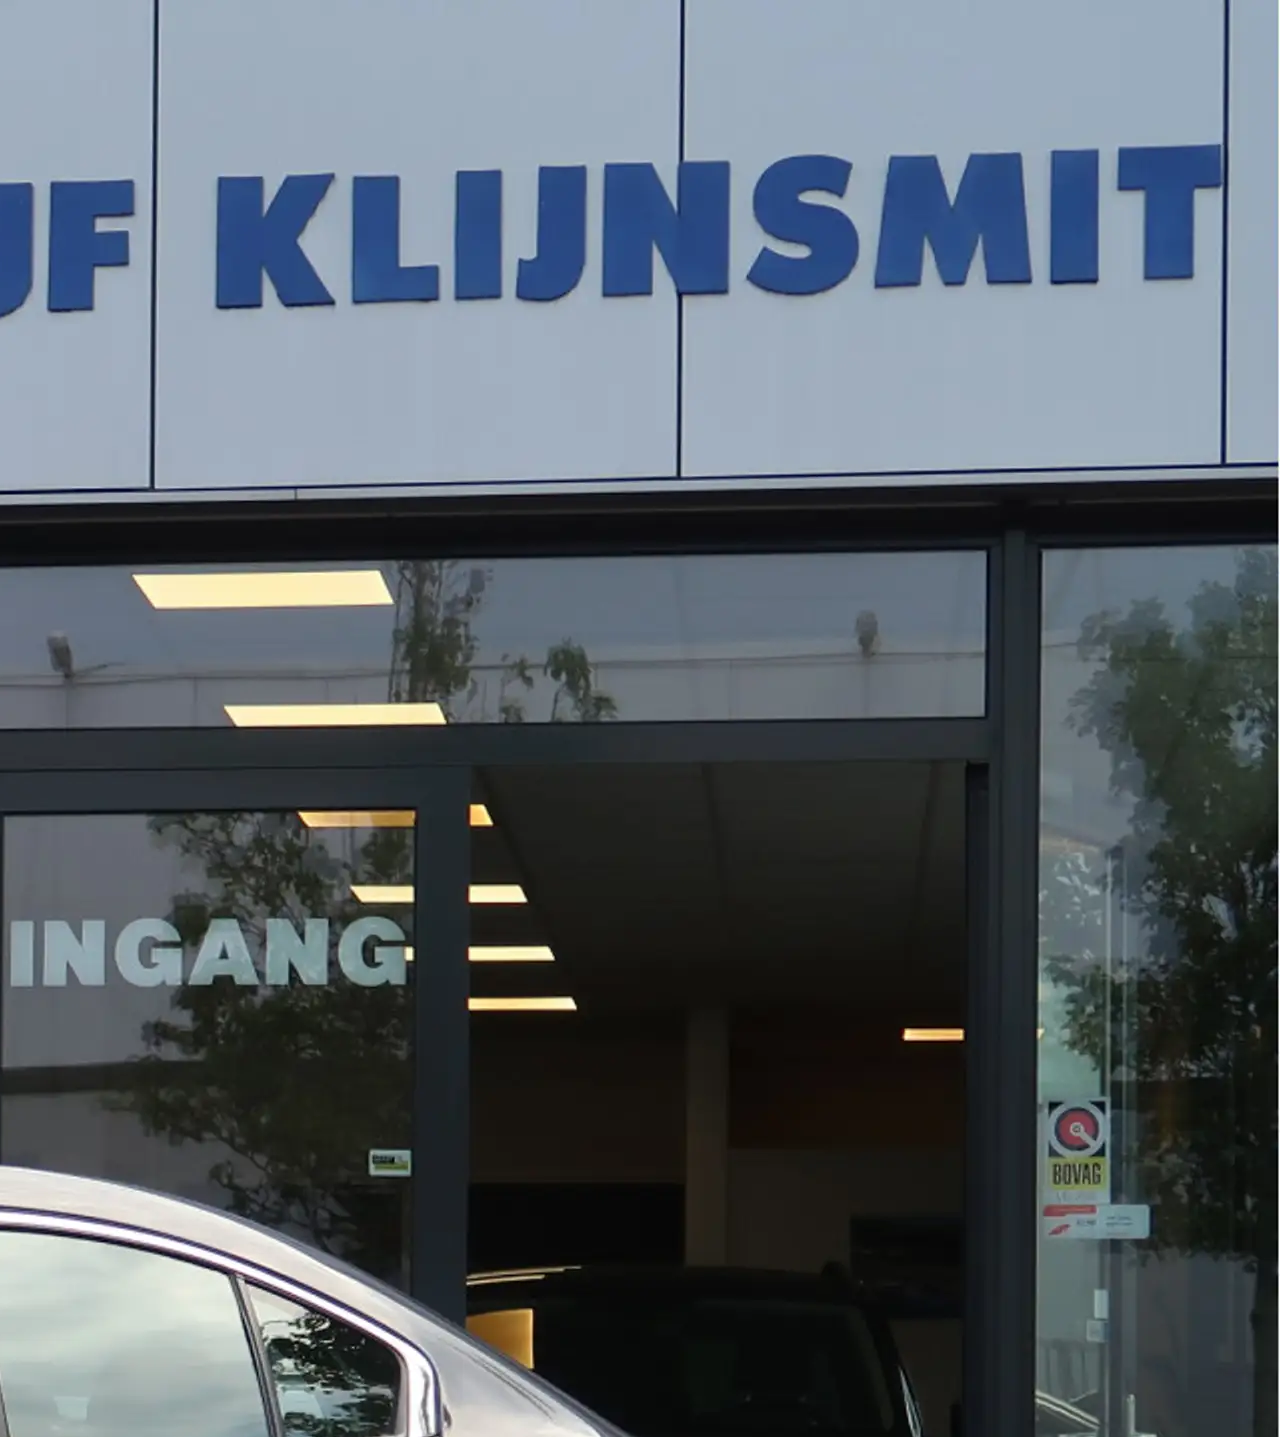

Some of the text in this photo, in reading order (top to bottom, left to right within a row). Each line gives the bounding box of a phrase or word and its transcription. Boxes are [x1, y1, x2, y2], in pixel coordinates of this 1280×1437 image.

[215, 144, 1223, 310] KLIJNSMIT
[9, 916, 407, 988] INGANG
[1052, 1163, 1102, 1186] BOVAG
